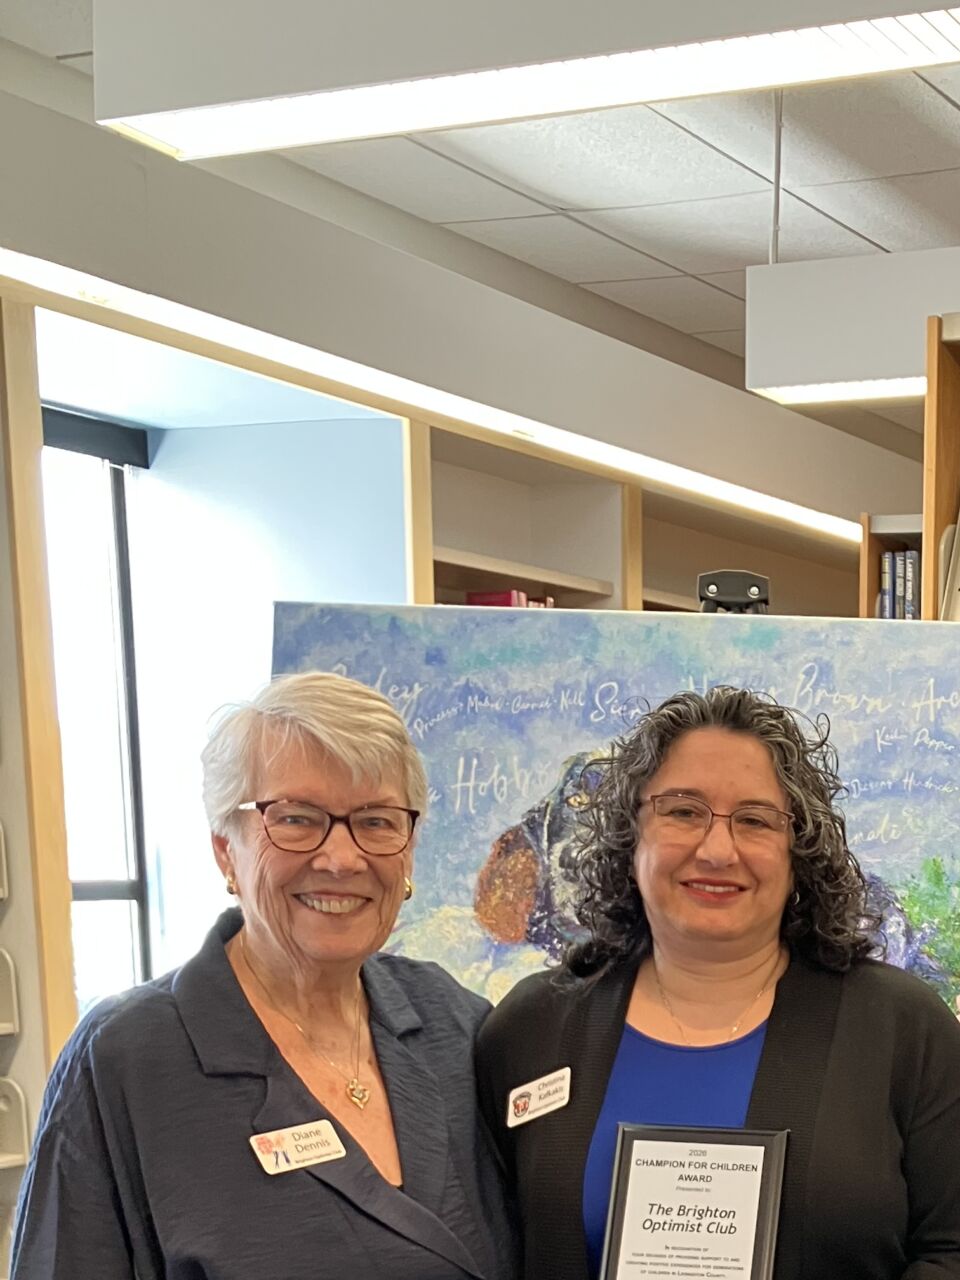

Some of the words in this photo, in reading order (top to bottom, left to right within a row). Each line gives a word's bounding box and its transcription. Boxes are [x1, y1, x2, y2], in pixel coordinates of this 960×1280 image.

[792, 663, 893, 714] Brown
[291, 1128, 321, 1142] Diane
[294, 1139, 331, 1153] Dennis
[635, 1158, 686, 1169] CHAMPION
[688, 1161, 708, 1170] FOR
[710, 1162, 758, 1172] CHILDREN
[677, 1174, 713, 1183] AWARD
[648, 1203, 673, 1216] The
[676, 1204, 736, 1220] Brighton
[642, 1218, 702, 1234] Optimist
[706, 1221, 737, 1235] Club
